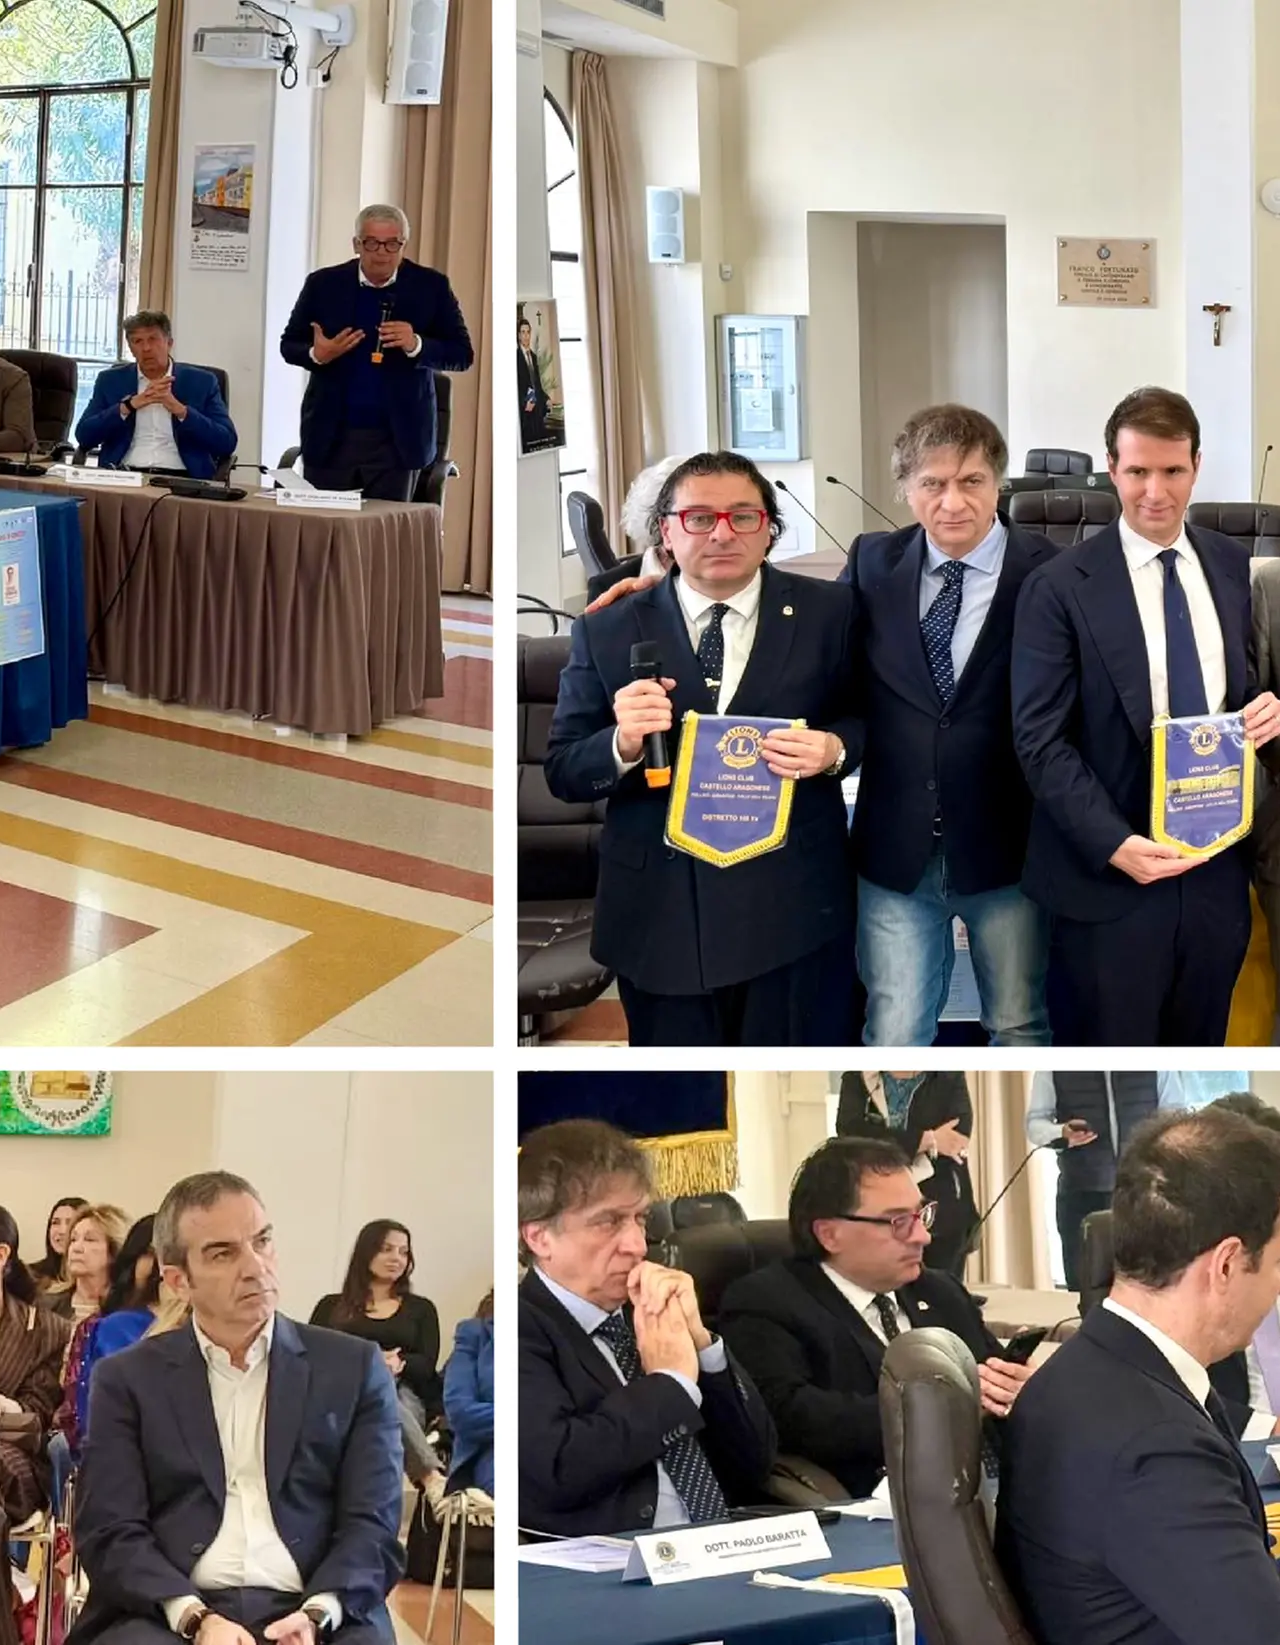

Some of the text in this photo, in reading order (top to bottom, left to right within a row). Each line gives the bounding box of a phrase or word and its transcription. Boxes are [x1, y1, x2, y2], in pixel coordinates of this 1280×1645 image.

[735, 739, 749, 754] L
[1201, 734, 1210, 746] L
[700, 782, 732, 790] CASTELLO
[704, 1541, 730, 1553] DOTT.
[734, 1535, 764, 1548] PAOLO
[765, 1529, 807, 1544] BARATTA
